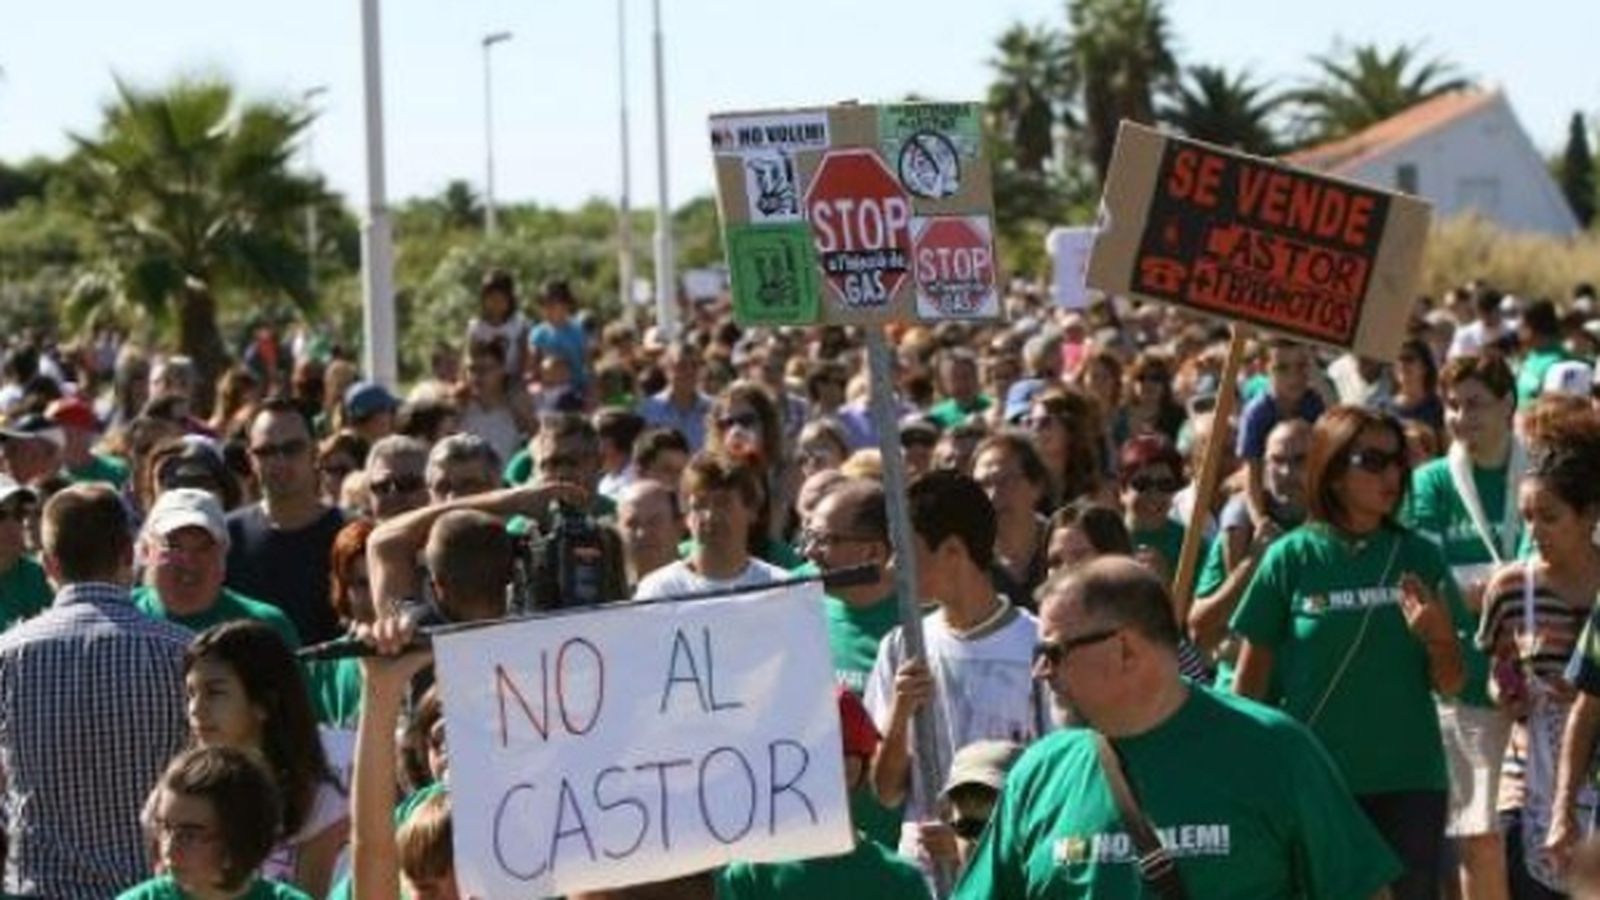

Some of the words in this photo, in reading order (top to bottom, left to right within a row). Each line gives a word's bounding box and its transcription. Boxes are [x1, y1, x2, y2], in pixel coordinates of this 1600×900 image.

[812, 197, 908, 253] STOP
[1169, 151, 1226, 207] SE
[1239, 167, 1377, 245] VENDE
[844, 270, 887, 305] GAS
[919, 247, 989, 281] STOP
[495, 637, 605, 748] NO
[659, 624, 744, 715] AL
[492, 739, 818, 883] CASTOR
[1092, 832, 1131, 862] HO
